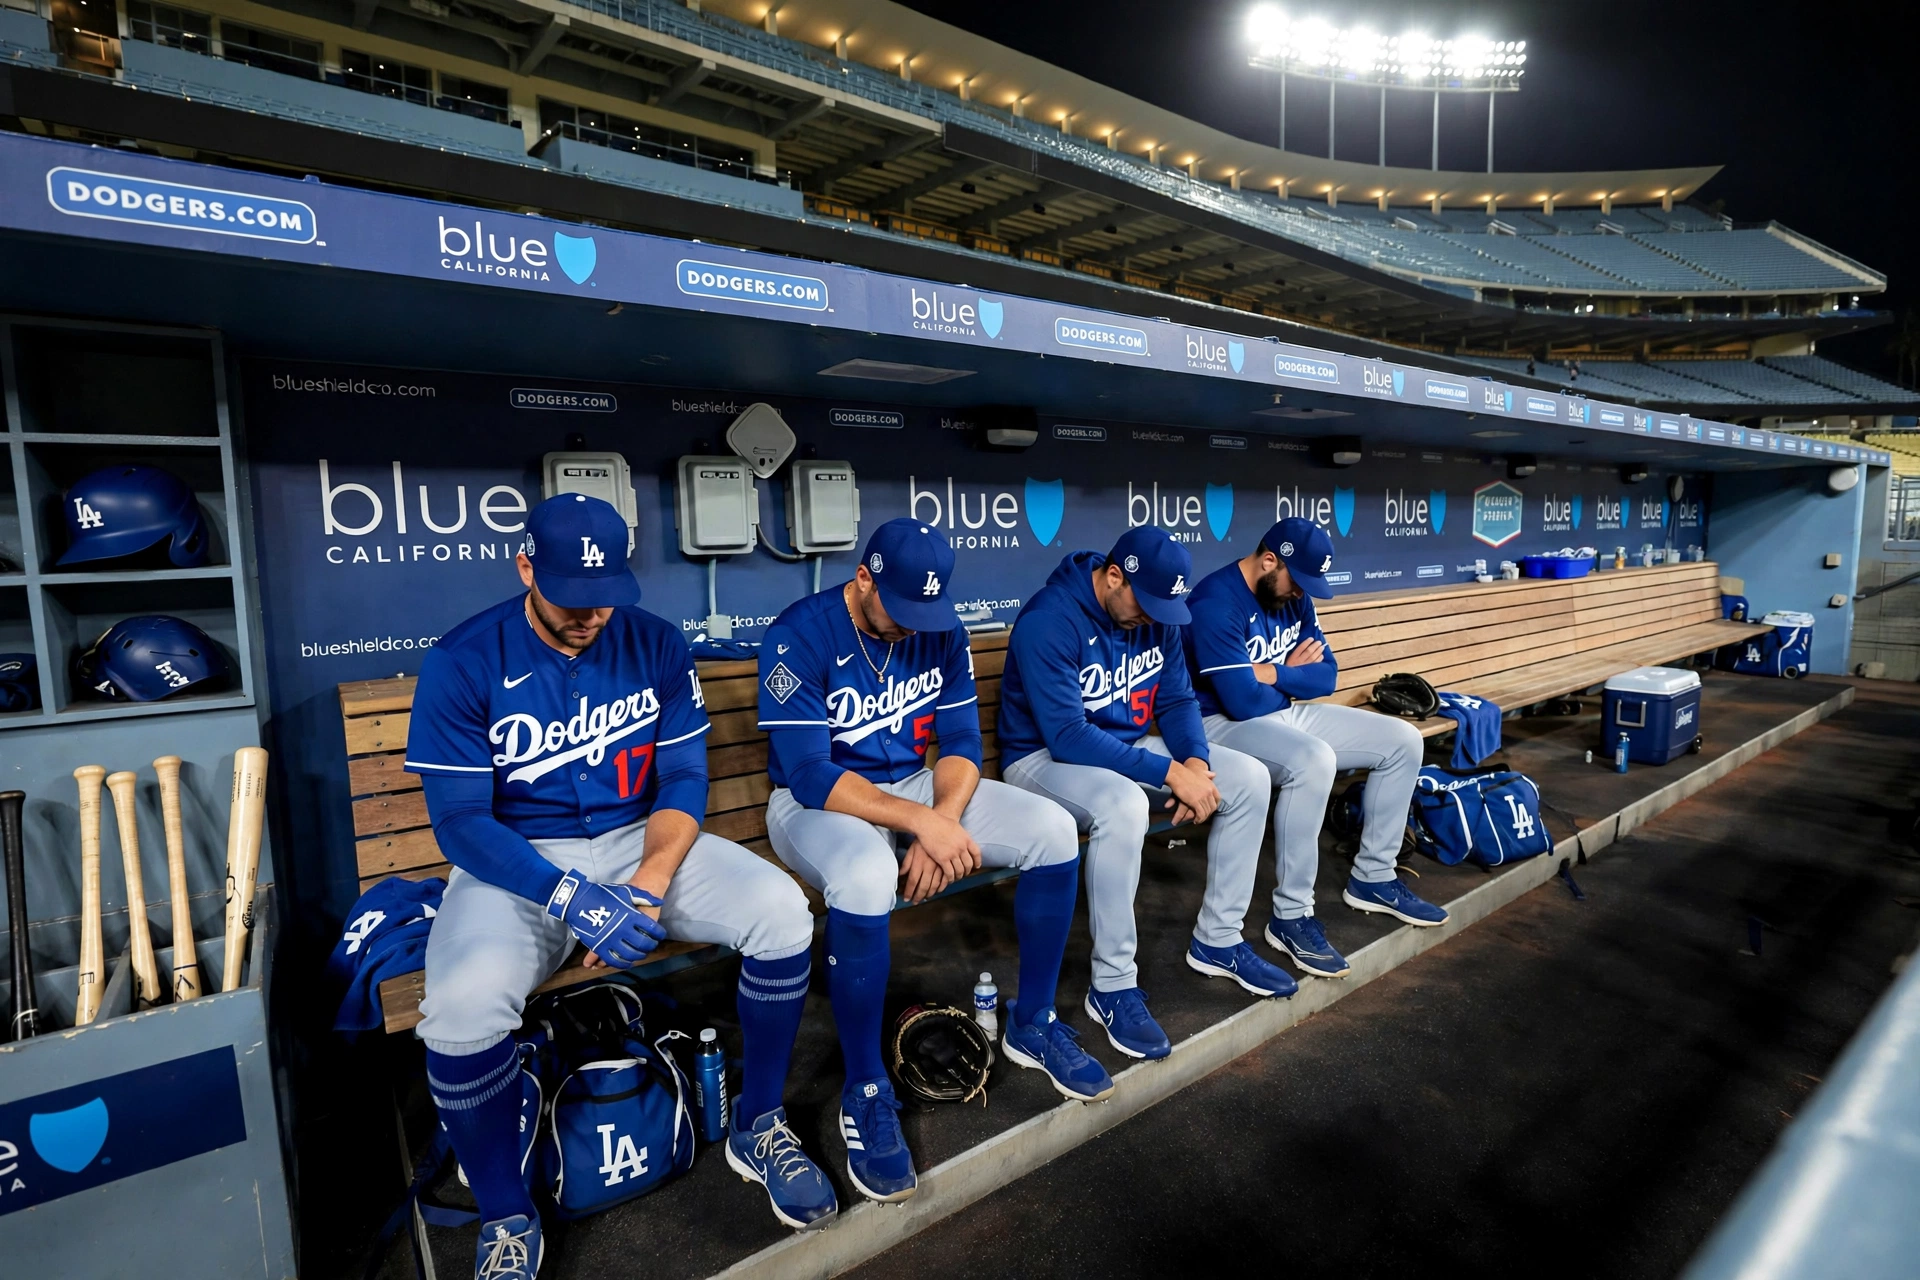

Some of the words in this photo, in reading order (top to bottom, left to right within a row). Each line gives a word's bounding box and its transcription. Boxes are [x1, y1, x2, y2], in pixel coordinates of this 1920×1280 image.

[67, 180, 302, 232] DODGERS.COM
[438, 216, 548, 267] blue
[441, 258, 550, 282] CALIFORNIA
[687, 269, 819, 302] DODGERS.COM
[911, 288, 976, 327] blue
[913, 321, 976, 337] CALIFORNIA
[1061, 324, 1142, 349] DODGERS.COM
[1186, 334, 1227, 363] blue
[1363, 365, 1392, 388] blue
[517, 393, 610, 408] DODGERS.COM
[1484, 387, 1504, 405] blue
[834, 412, 899, 425] DODGERS.COM
[318, 459, 527, 536] blue
[909, 475, 1019, 529] blue
[1128, 481, 1202, 528] blue
[1276, 485, 1332, 525] blue
[1385, 488, 1428, 525] blue
[1544, 493, 1571, 522] blue
[1597, 495, 1620, 521] blue
[1642, 495, 1662, 520] blue
[74, 497, 104, 529] LA
[950, 535, 1020, 549] IFORNIA
[1384, 527, 1428, 537] CALIFORNIA
[581, 537, 604, 567] LA
[923, 571, 941, 595] LA
[1746, 643, 1761, 663] LA
[826, 666, 944, 747] Dodgers
[489, 687, 661, 784] Dodgers
[913, 713, 935, 756] 5
[614, 742, 657, 799] 17
[1504, 794, 1536, 840] LA
[579, 906, 611, 927] LA
[597, 1123, 648, 1187] LA
